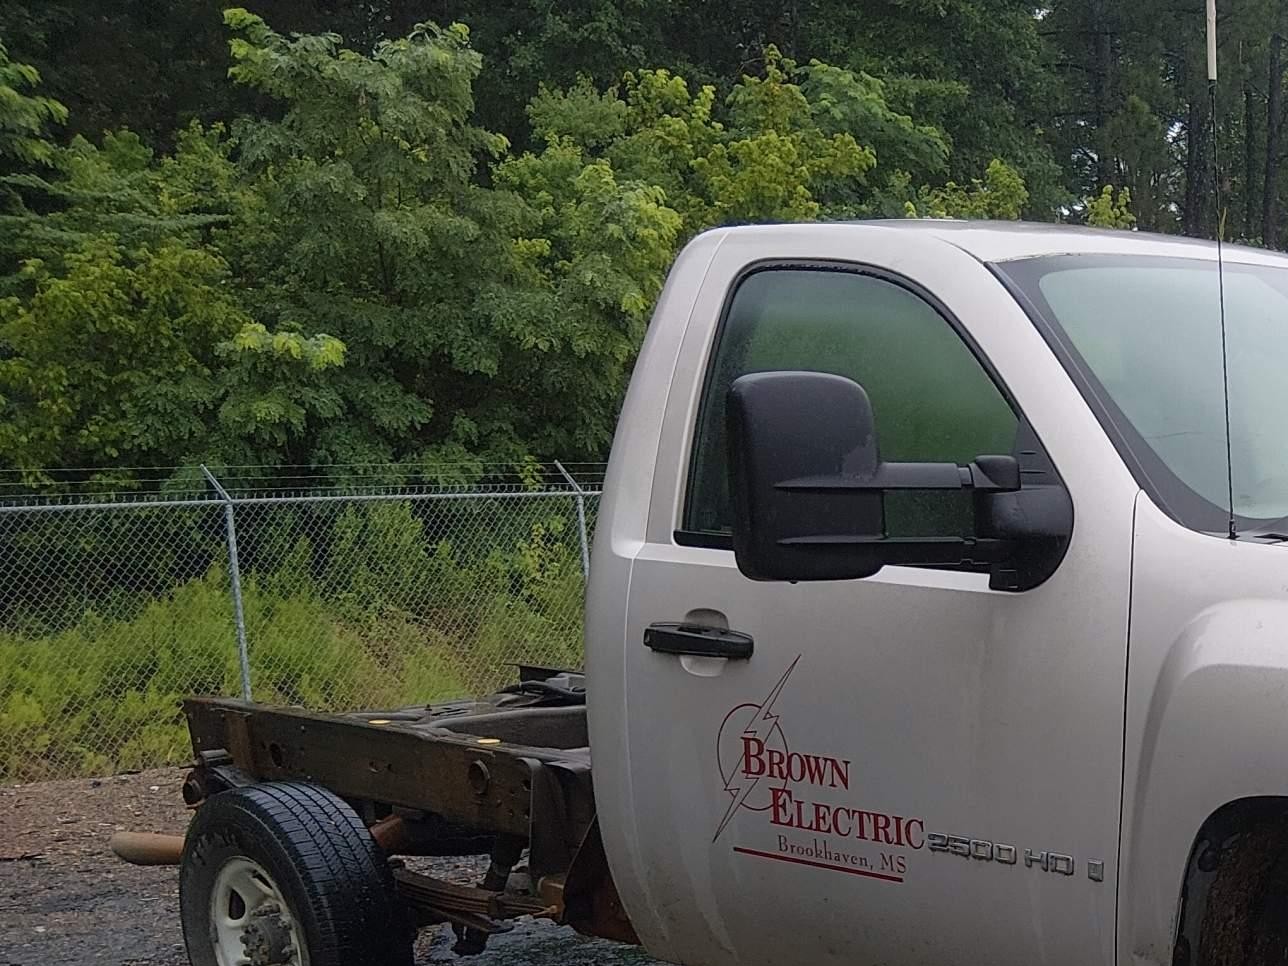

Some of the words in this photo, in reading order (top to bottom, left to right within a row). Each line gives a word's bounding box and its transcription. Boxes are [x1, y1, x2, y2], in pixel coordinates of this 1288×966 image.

[740, 736, 851, 790] BROWN
[768, 787, 925, 849] ELECTRIC
[777, 834, 873, 870] Brookhaven,
[880, 852, 907, 874] MS
[928, 832, 1017, 865] 2500
[1024, 848, 1074, 876] HD
